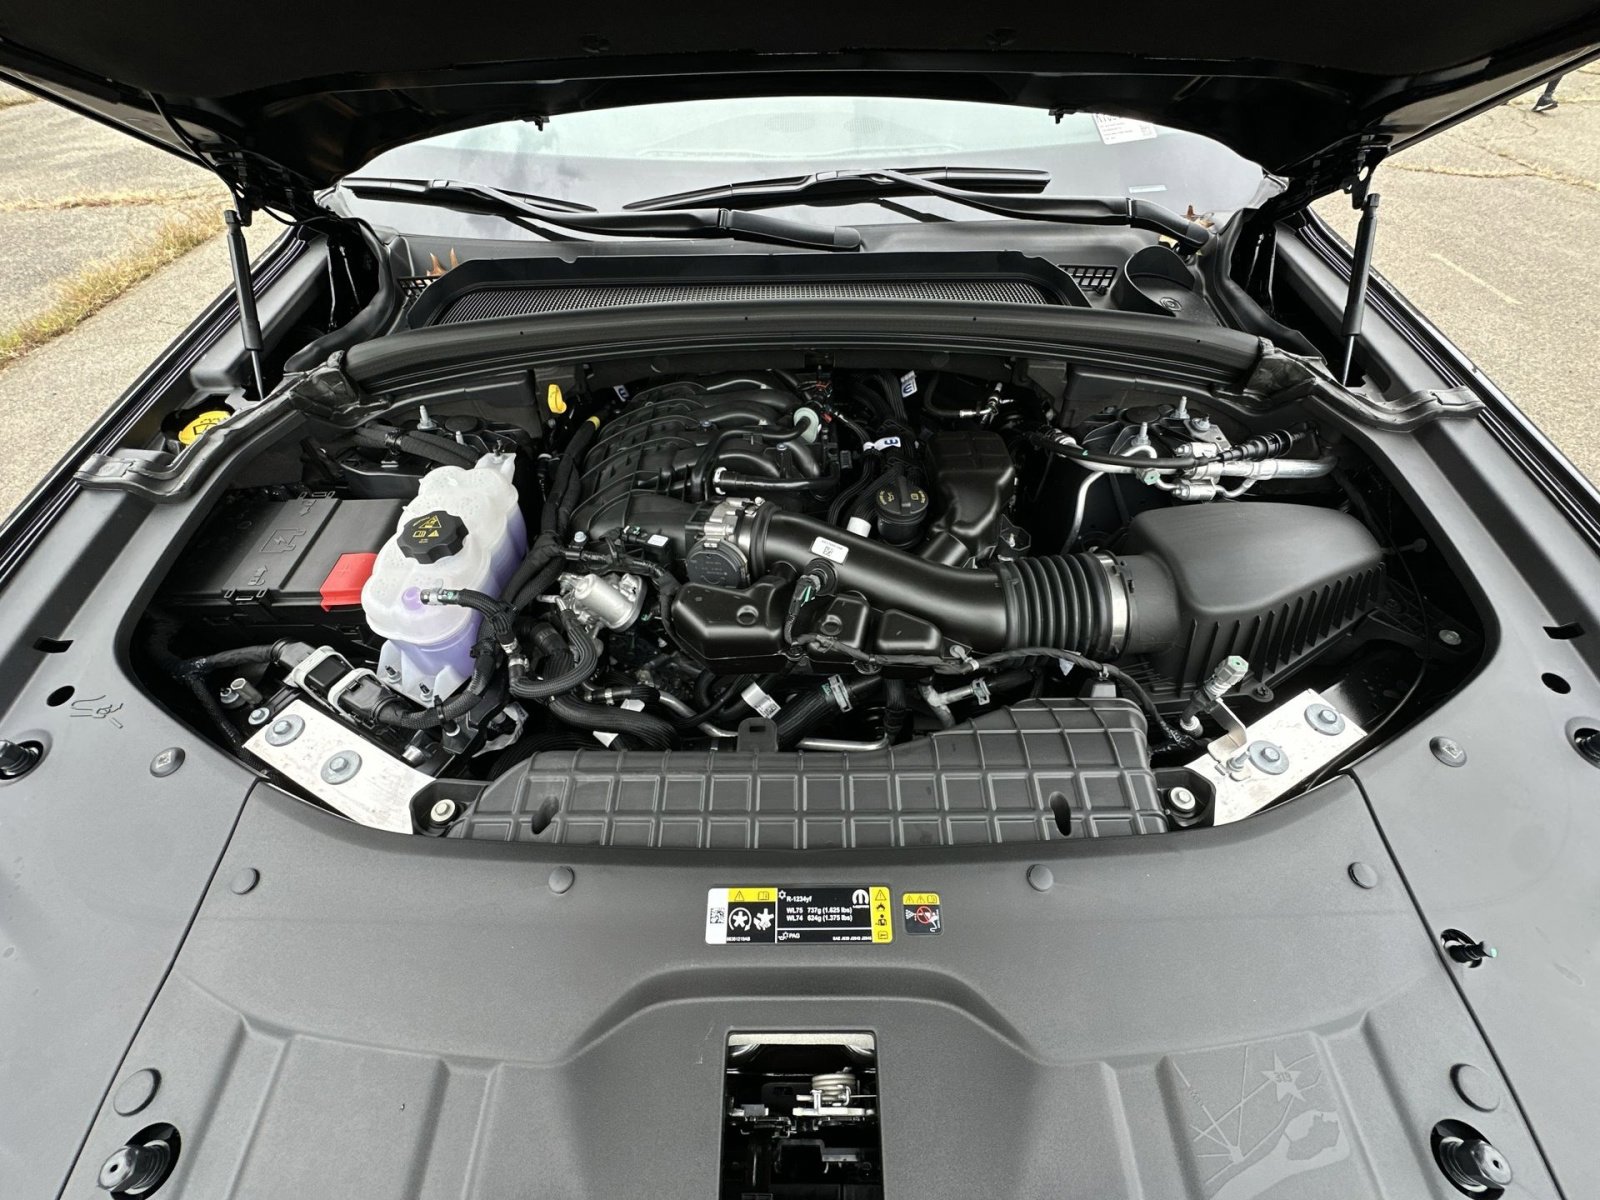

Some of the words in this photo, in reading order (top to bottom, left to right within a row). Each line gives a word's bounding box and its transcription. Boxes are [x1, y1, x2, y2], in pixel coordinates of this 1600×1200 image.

[807, 907, 822, 915] 737g
[822, 906, 840, 914] (1.625
[841, 906, 853, 914] lbs)
[1273, 1071, 1293, 1083] 313
